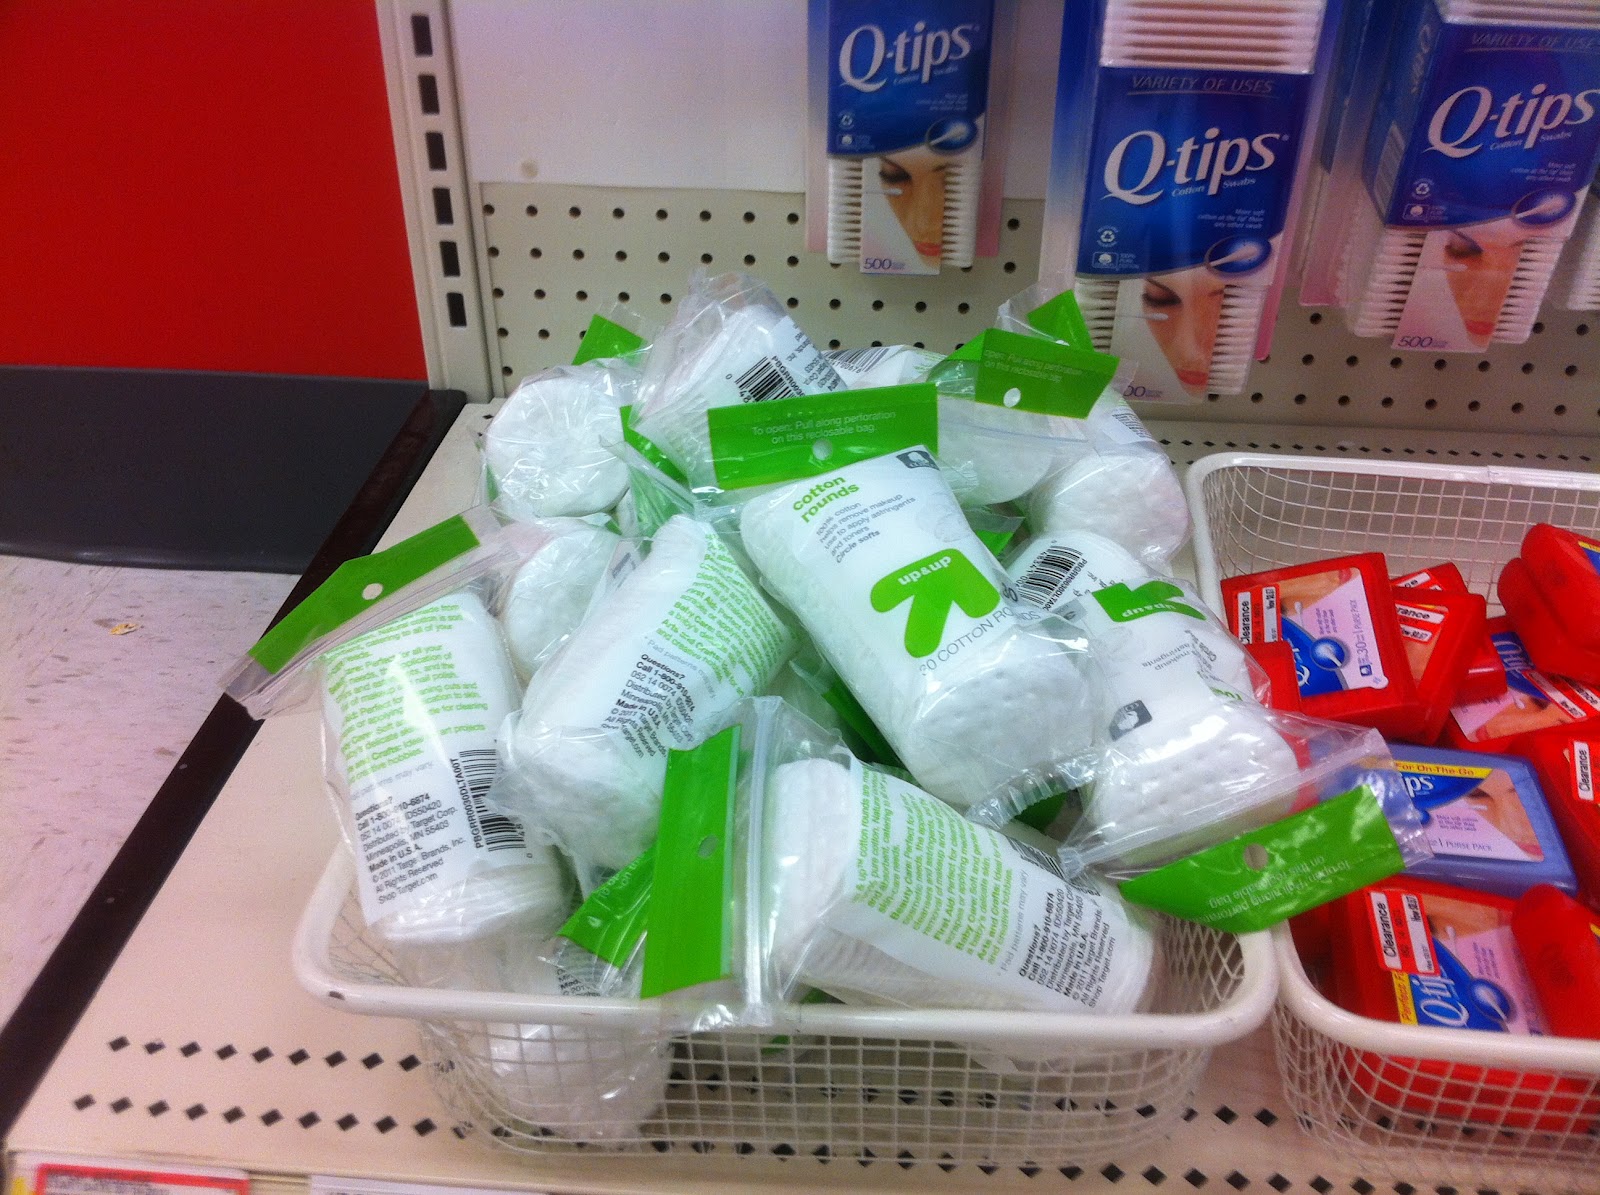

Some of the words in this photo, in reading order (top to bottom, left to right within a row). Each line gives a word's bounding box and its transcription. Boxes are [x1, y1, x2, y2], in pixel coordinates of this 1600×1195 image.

[838, 20, 976, 92] Q-tips
[1132, 75, 1199, 90] VARIETY
[1202, 79, 1228, 92] OF
[1231, 80, 1274, 94] USES
[1422, 83, 1600, 158] Q-tips
[1100, 127, 1281, 206] Q-tips
[1171, 185, 1206, 198] Cotton
[1222, 177, 1256, 189] Swabs
[863, 258, 892, 270] 500
[1398, 336, 1433, 348] 500
[1122, 385, 1146, 398] 00
[752, 427, 764, 435] To
[795, 420, 814, 430] Pull
[815, 417, 842, 428] along
[844, 411, 897, 424] perforation
[772, 436, 784, 444] on
[786, 433, 804, 442] this
[805, 426, 854, 439] reclosable
[793, 476, 847, 512] cotton
[801, 484, 860, 524] rounds
[820, 523, 838, 543] helps
[838, 508, 870, 525] remove
[869, 494, 903, 510] makeup
[834, 502, 862, 517] cotton
[824, 535, 838, 550] use
[837, 528, 846, 536] to
[847, 517, 871, 530] apply
[870, 497, 916, 519] astringents
[831, 540, 844, 557] and
[843, 526, 870, 542] toners
[836, 542, 858, 564] Circle
[858, 530, 881, 544] softs
[898, 556, 952, 586] up&up
[661, 618, 679, 633] Arts
[1240, 600, 1251, 643] Clearance
[1396, 605, 1431, 621] rance
[647, 639, 664, 652] Pad
[656, 627, 673, 642] and
[671, 639, 702, 660] creative
[937, 618, 995, 662] COTTON
[992, 606, 1042, 623] RODS
[635, 661, 653, 674] Call
[640, 653, 686, 681] Questions?
[625, 679, 669, 701] Distributed
[630, 670, 647, 682] 052
[647, 676, 658, 687] 14
[657, 681, 677, 697] 0074
[615, 698, 638, 711] Made
[1580, 748, 1591, 792] Clearance
[357, 819, 370, 832] Call
[362, 829, 399, 853] Distributed
[410, 814, 436, 829] Target
[372, 825, 382, 836] 14
[424, 819, 450, 836] 55403
[368, 858, 388, 874] Made
[388, 854, 398, 863] in
[379, 865, 397, 880] 2011
[384, 874, 408, 889] Rights
[407, 856, 444, 878] Reserved
[378, 891, 397, 905] Shop
[1011, 911, 1025, 953] patterns
[1018, 889, 1029, 913] may
[1063, 901, 1075, 928] Target
[1048, 930, 1060, 955] 0074
[1062, 929, 1072, 942] by
[1071, 920, 1082, 939] MN
[1094, 921, 1111, 963] Reserved
[1378, 902, 1398, 959] Clearance
[1018, 923, 1041, 978] Questions?
[1044, 956, 1054, 968] 14
[1027, 962, 1041, 982] Call
[1036, 968, 1049, 986] 052
[1045, 941, 1069, 990] Distributed
[1063, 970, 1079, 998] Made
[1073, 959, 1082, 971] in
[1075, 968, 1087, 992] 2011
[1083, 940, 1097, 968] Target
[1085, 964, 1100, 993] Rights
[1088, 985, 1104, 1009] Shop
[1099, 936, 1117, 984] Target.com
[1080, 991, 1091, 1006] All
